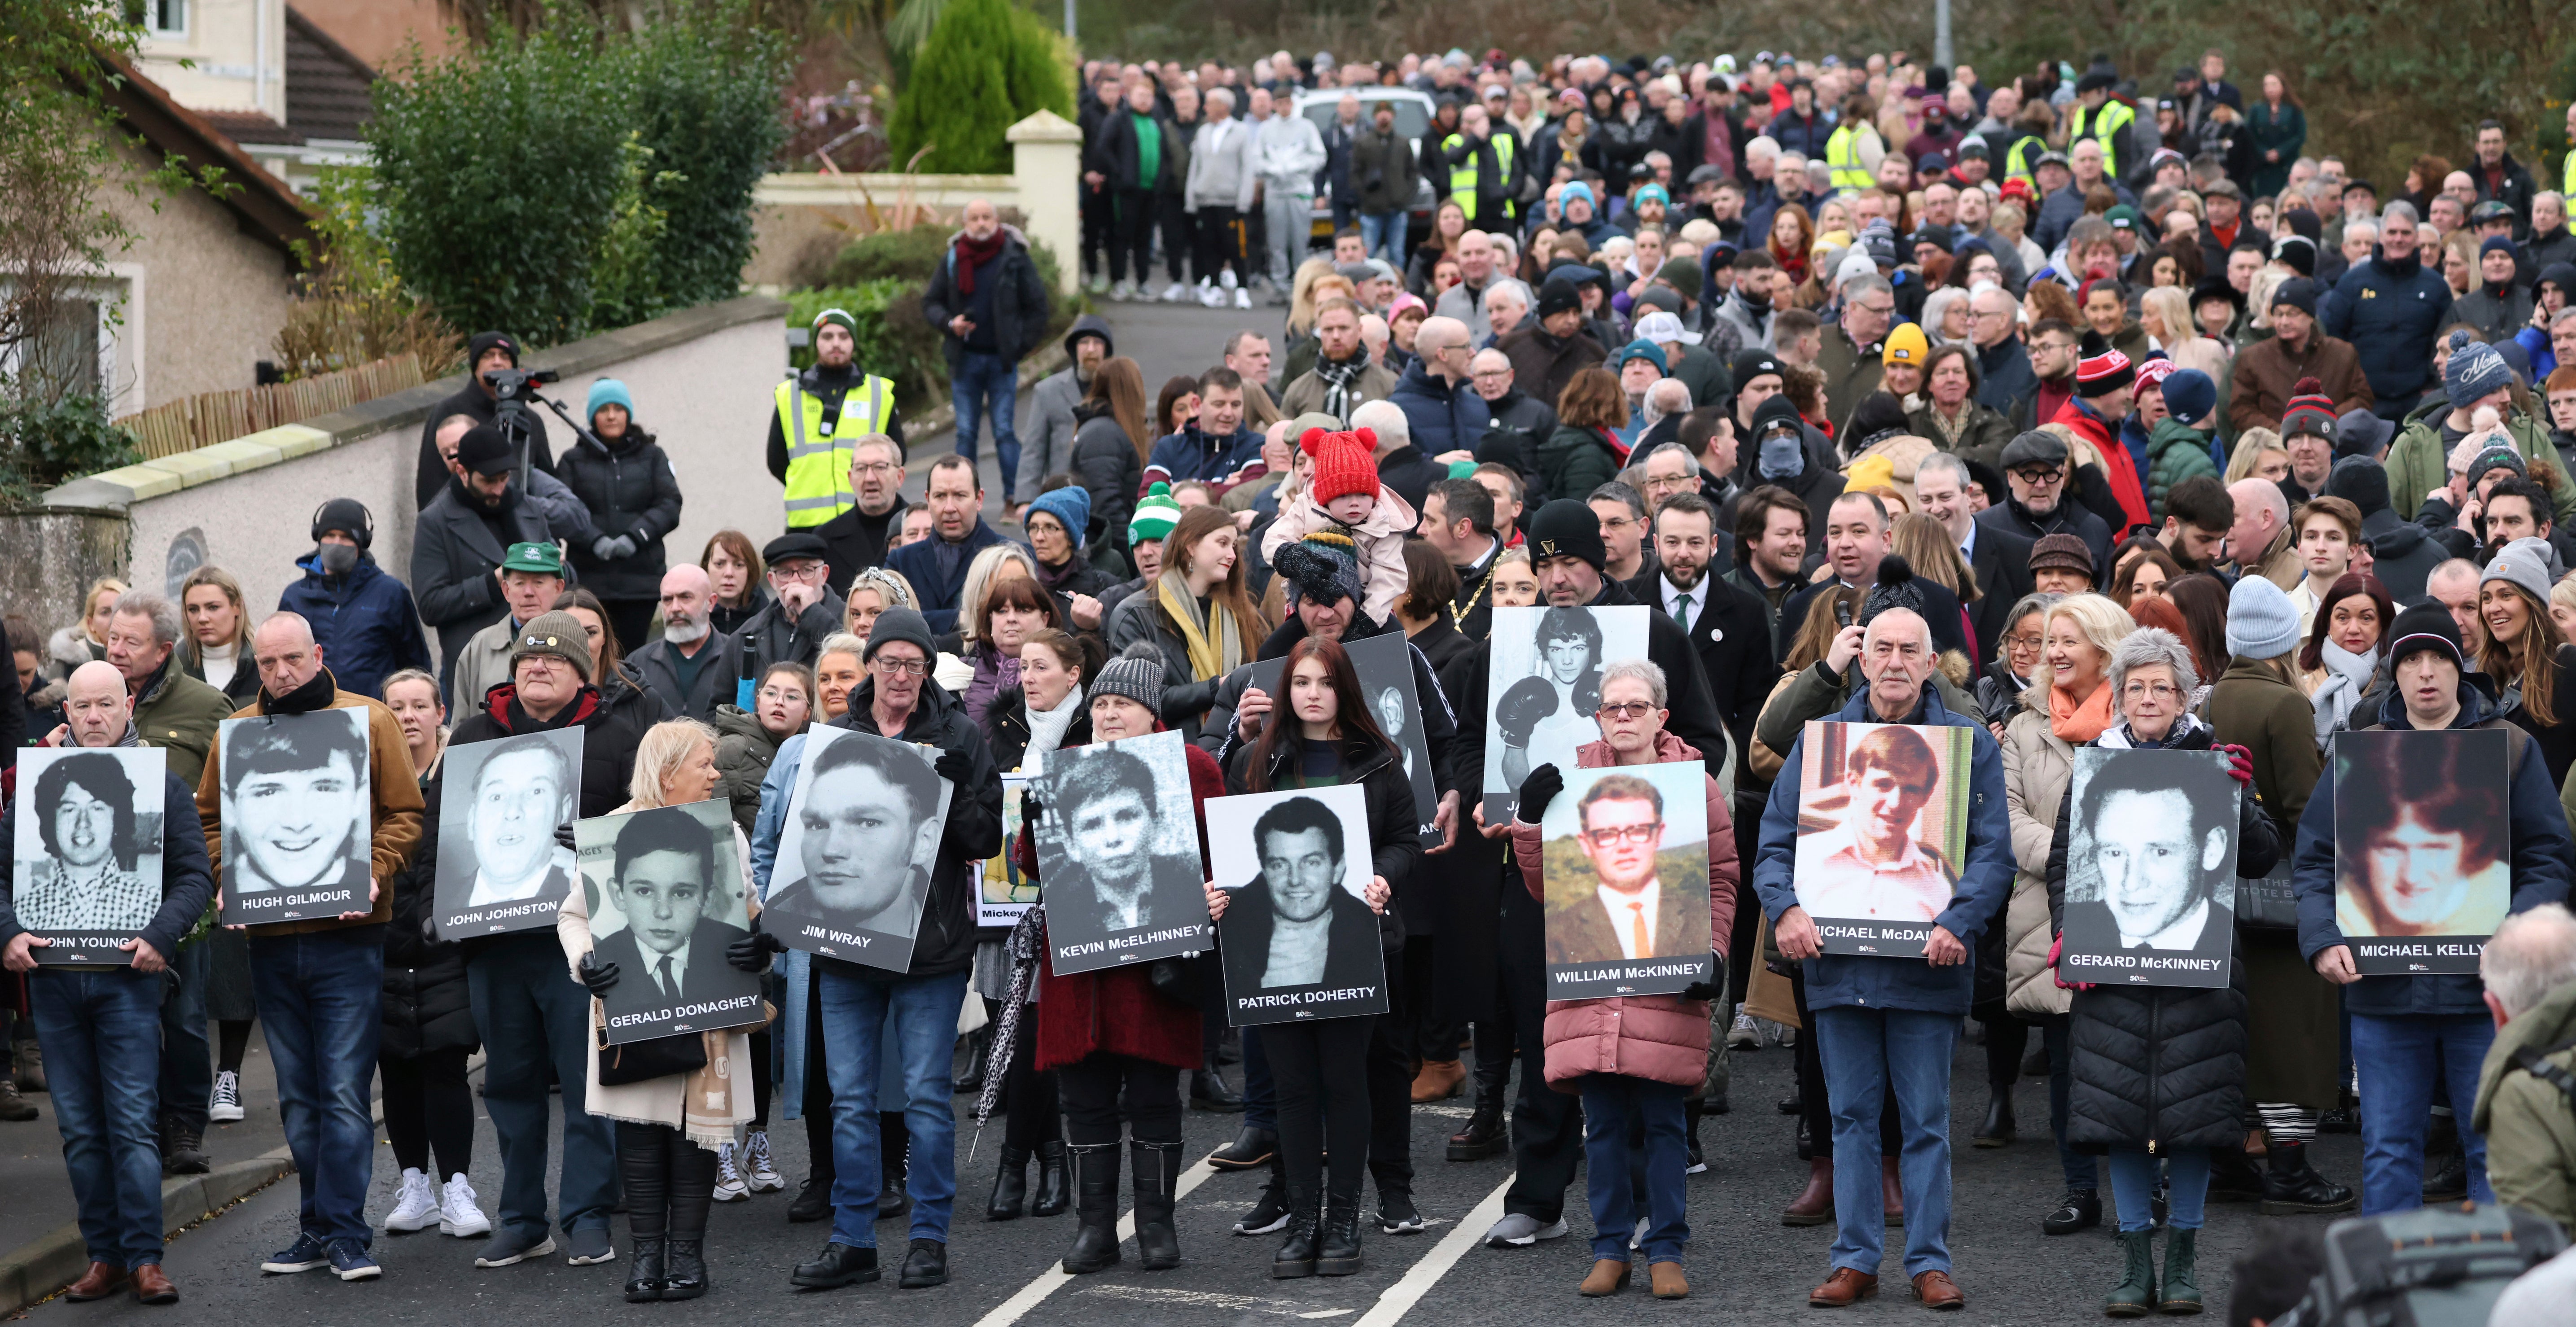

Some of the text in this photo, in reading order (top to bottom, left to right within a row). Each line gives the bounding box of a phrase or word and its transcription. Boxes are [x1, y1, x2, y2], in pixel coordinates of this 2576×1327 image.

[2262, 878, 2291, 887] THE
[242, 889, 351, 910] HUGH GILMOUR
[2241, 887, 2278, 898] TOTE
[446, 900, 557, 927] JOHN JOHNSTON
[982, 910, 1023, 918] Mickey
[43, 937, 129, 948] OHN YOUNG
[801, 925, 872, 948] JIM WRAY
[1060, 924, 1202, 958] KEVIN McELHINNEY
[1881, 928, 1933, 941] McDAI
[2360, 944, 2487, 956] MICHAEL KELLY
[2069, 954, 2221, 971] GERARD McKINNEY
[1555, 963, 1704, 983] WILLIAM McKINNEY
[1239, 986, 1376, 1009] PATRICK DOHERTY
[610, 995, 758, 1028] GERALD DONAGHEY
